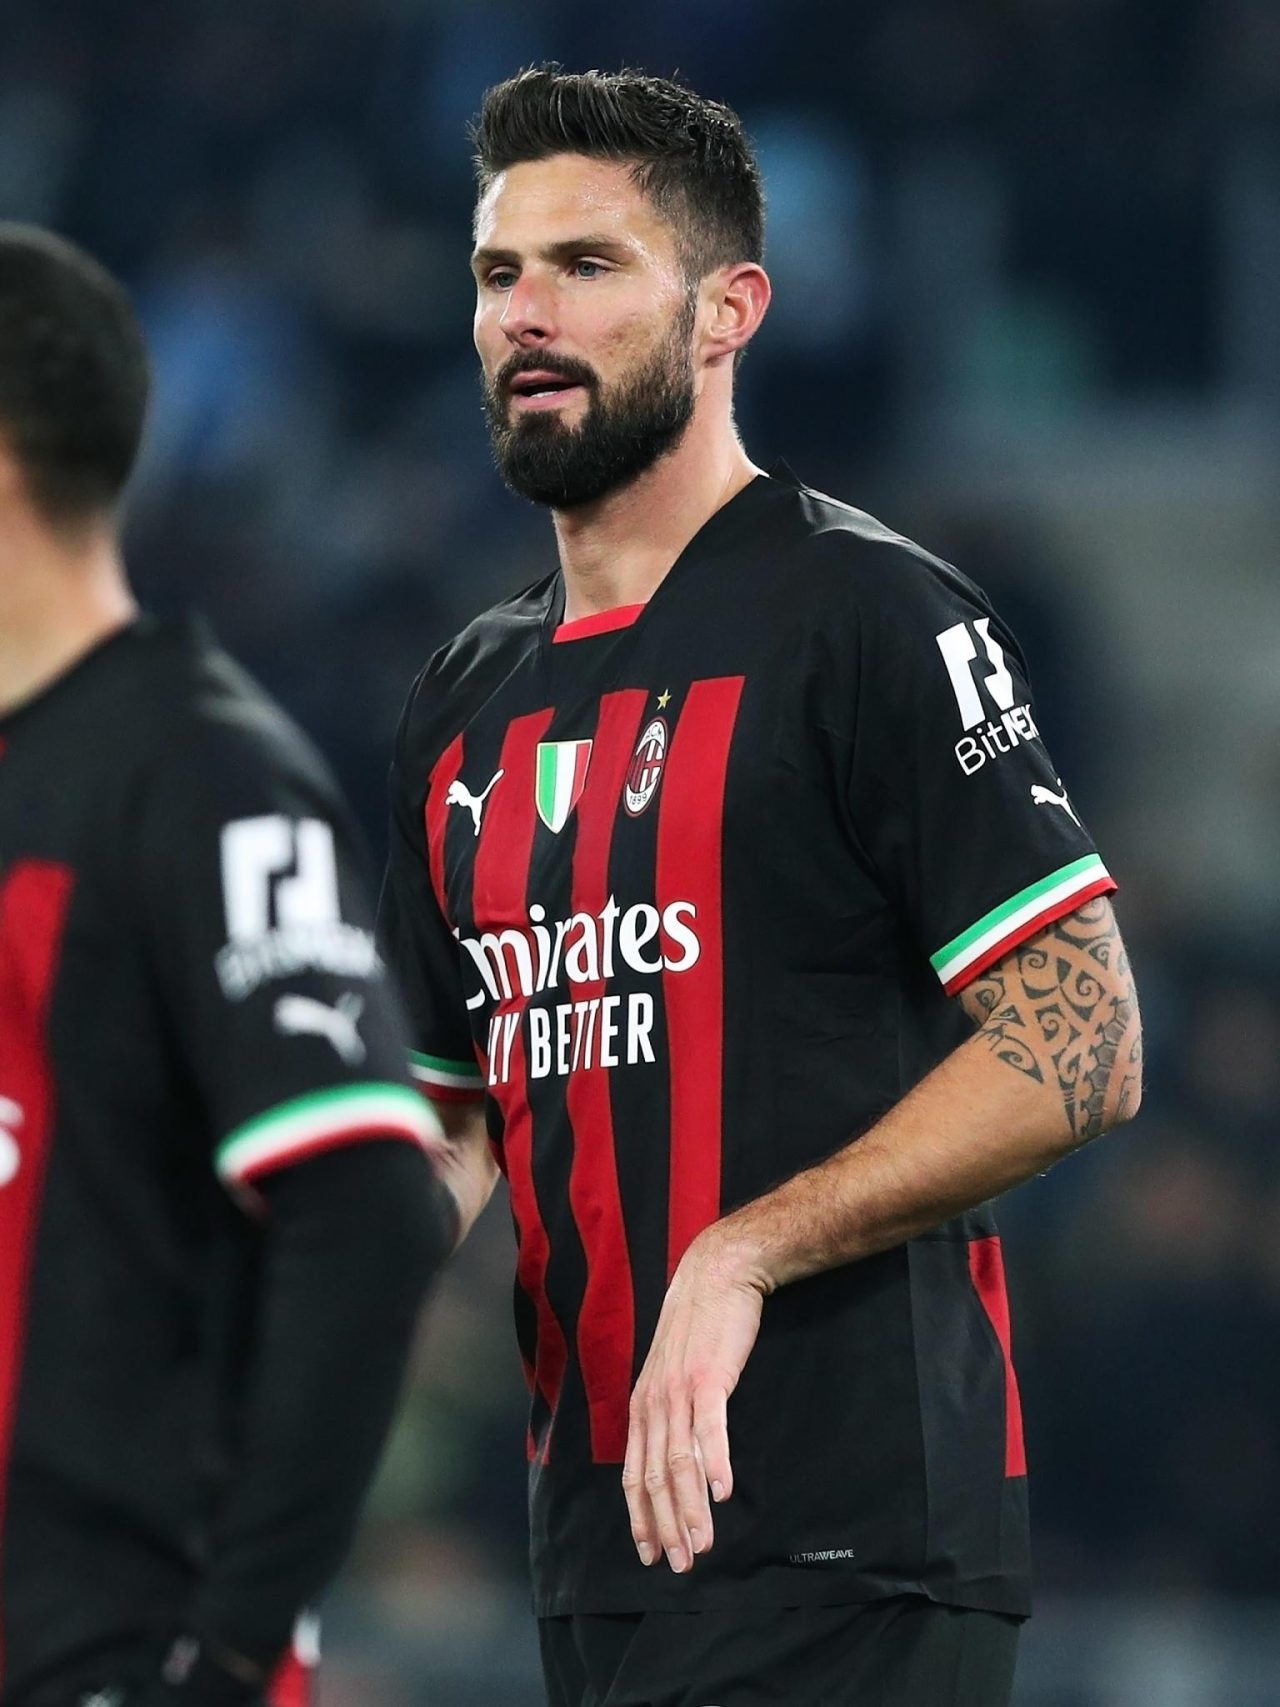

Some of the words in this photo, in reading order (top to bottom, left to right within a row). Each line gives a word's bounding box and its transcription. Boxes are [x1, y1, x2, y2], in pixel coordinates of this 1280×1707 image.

[487, 1012, 520, 1086] LY
[529, 992, 656, 1079] BETTER
[789, 1549, 855, 1563] ULTRAWEAVE
